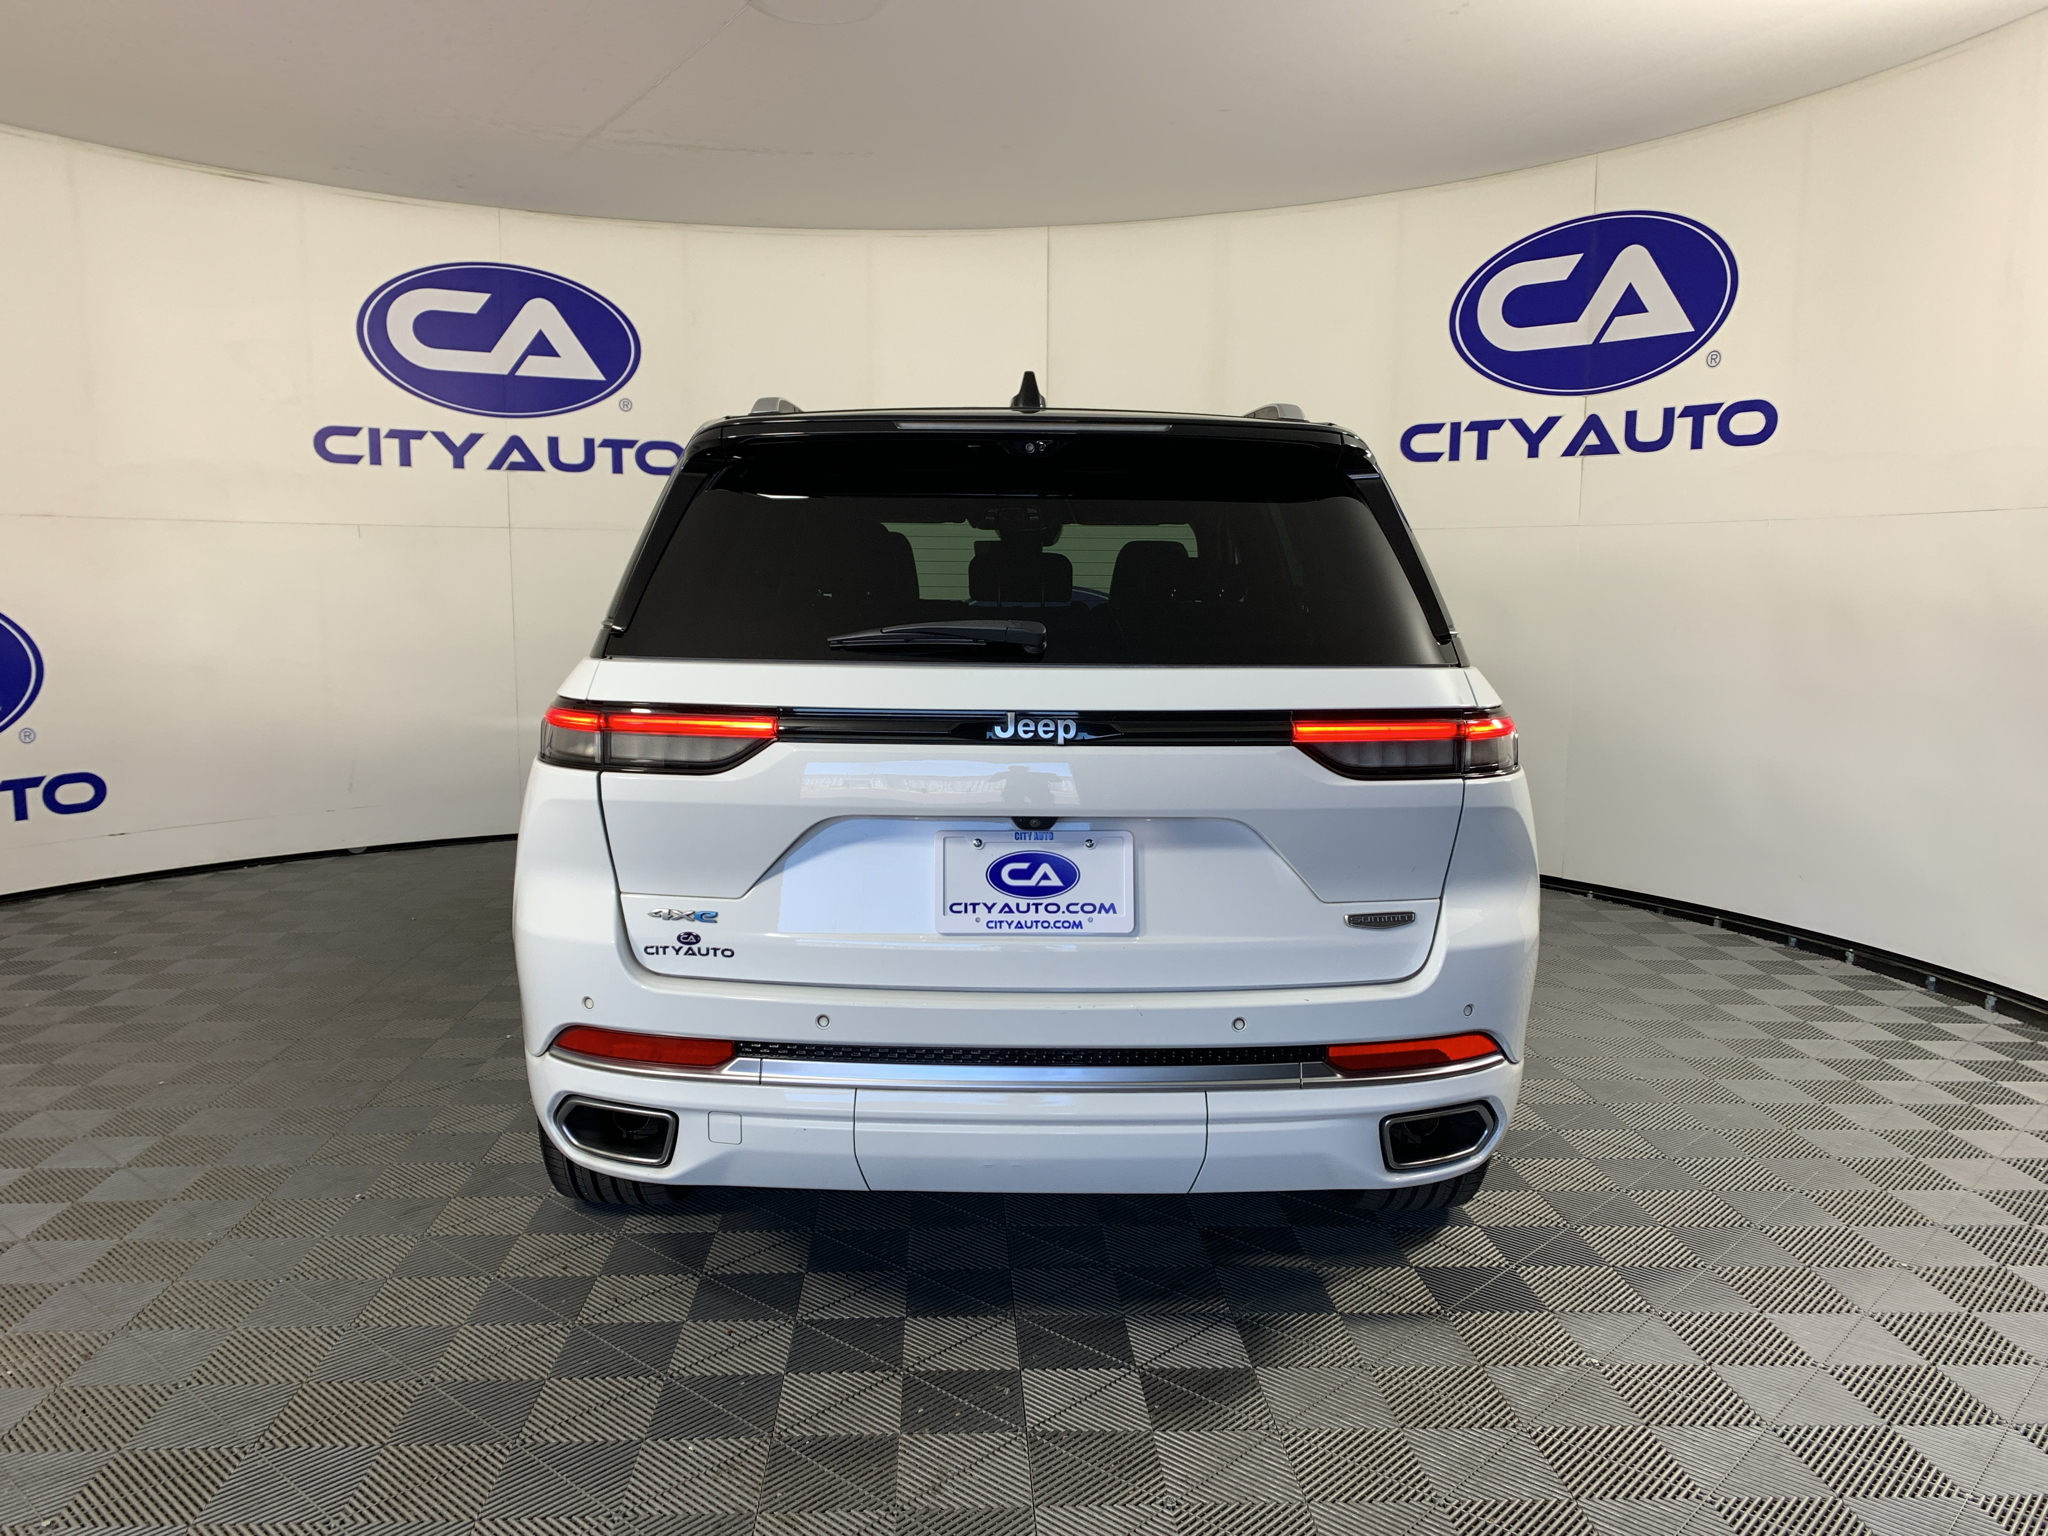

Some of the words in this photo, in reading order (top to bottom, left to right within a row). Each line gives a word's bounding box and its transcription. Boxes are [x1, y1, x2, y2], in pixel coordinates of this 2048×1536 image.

[1477, 244, 1696, 352] CA
[386, 287, 607, 381] CA
[994, 711, 1077, 745] Jeep
[1014, 831, 1032, 841] CITY
[1033, 831, 1054, 841] AUTO
[1000, 862, 1065, 887] CA
[949, 902, 1118, 915] CITYAUTO.COM
[985, 920, 1084, 930] CITYAUTO.COM
[679, 934, 697, 943] CA
